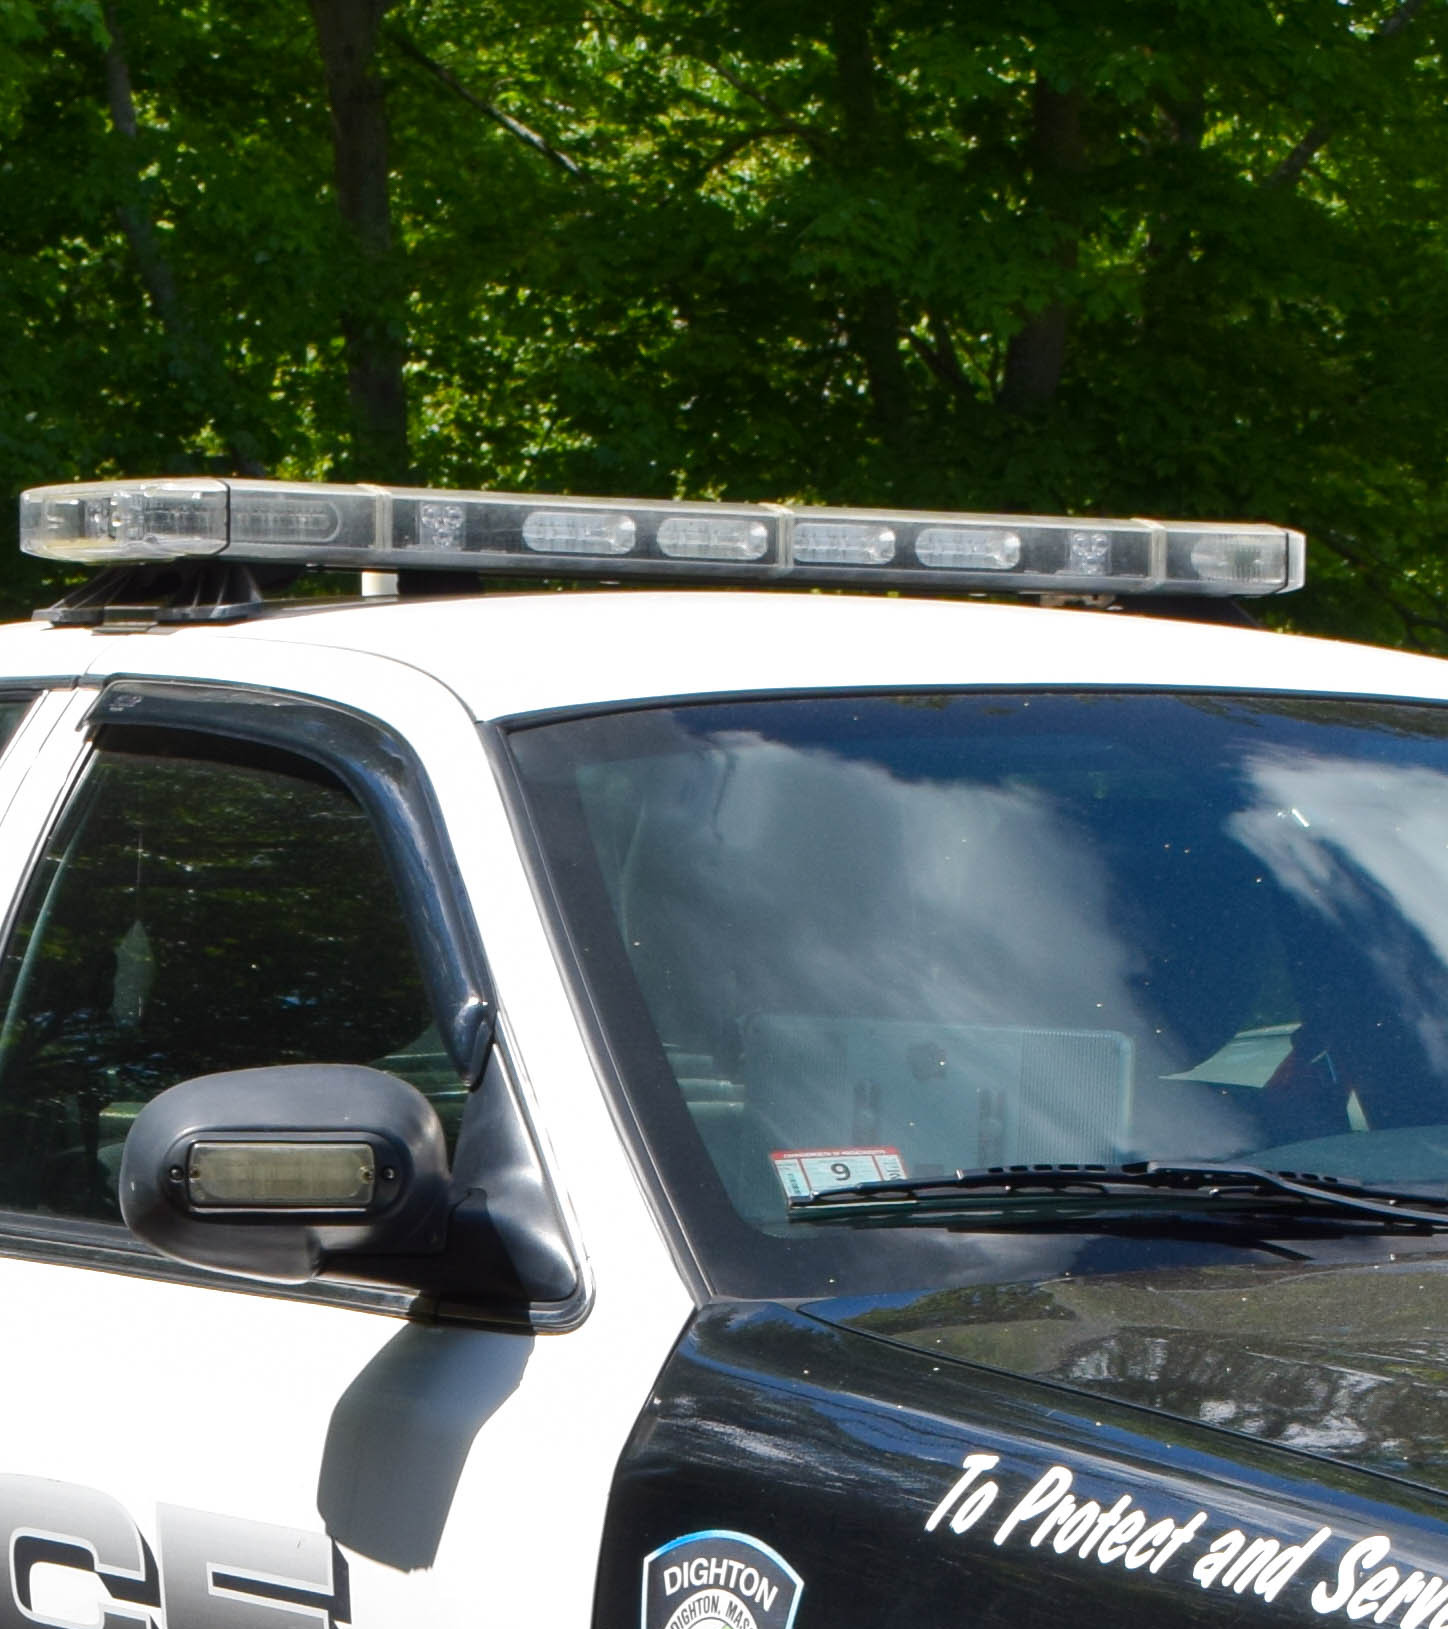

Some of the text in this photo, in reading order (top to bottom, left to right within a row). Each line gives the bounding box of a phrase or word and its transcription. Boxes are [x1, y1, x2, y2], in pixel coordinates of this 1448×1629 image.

[830, 1162, 851, 1181] 9
[925, 1453, 999, 1534] To
[995, 1465, 1206, 1575] Protect
[1193, 1525, 1333, 1604] and
[663, 1557, 778, 1612] DIGHTON
